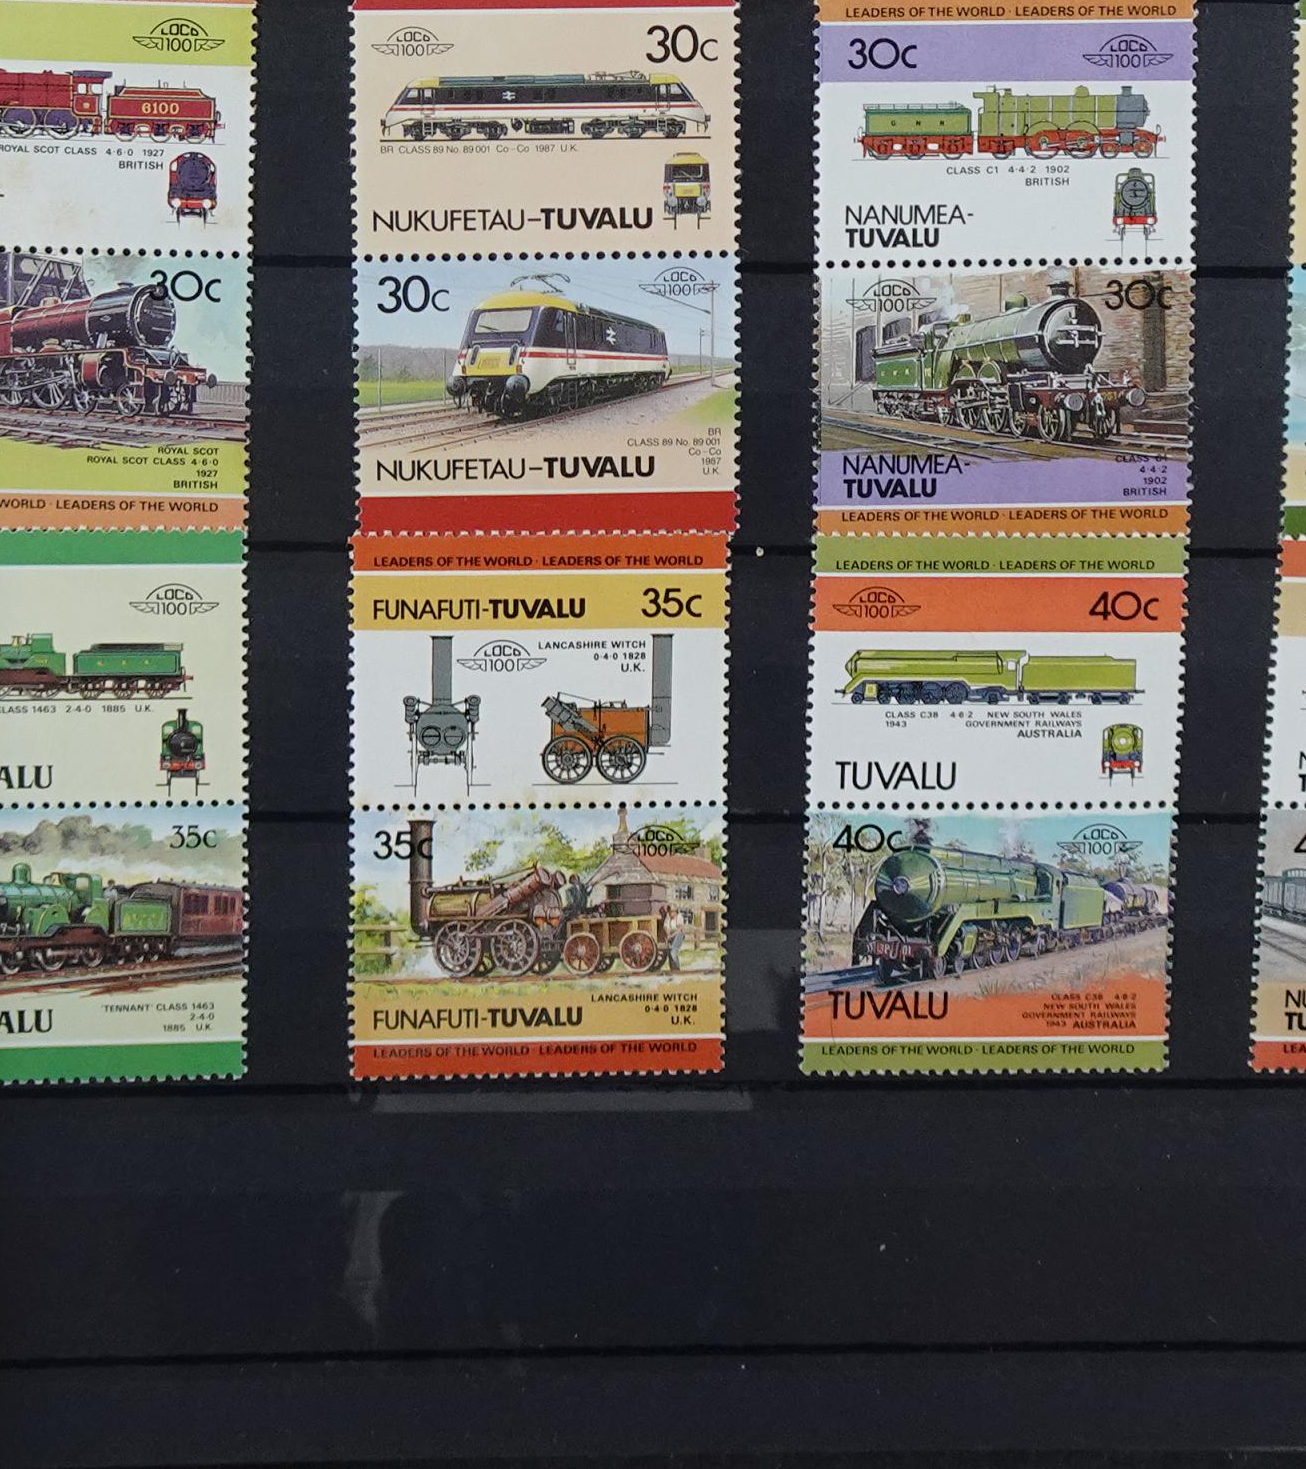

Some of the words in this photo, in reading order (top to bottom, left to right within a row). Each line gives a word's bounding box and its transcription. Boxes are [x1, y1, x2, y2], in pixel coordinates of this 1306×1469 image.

[645, 24, 718, 64] 30c
[847, 38, 918, 70] 30c
[141, 102, 180, 116] 6100
[142, 148, 164, 158] 1927
[398, 145, 432, 154] CLASS
[534, 144, 555, 153] 1987
[118, 160, 164, 170] BRITISH
[946, 165, 981, 175] CLASS
[1045, 165, 1070, 174] 1902
[1024, 177, 1070, 187] BRITISH
[845, 228, 940, 248] TUVALU
[149, 269, 222, 304] 30c
[376, 275, 450, 314] 30c
[1105, 279, 1173, 311] 30c
[173, 479, 219, 490] BRITISH
[843, 478, 937, 499] TUVALU
[1122, 487, 1167, 497] BRITISH
[640, 588, 703, 618] 35c
[1088, 591, 1159, 621] 40c
[538, 640, 607, 650] LANCASHIRE
[611, 639, 647, 649] WITCH
[31, 705, 57, 714] 1463
[885, 711, 916, 719] CLASS
[987, 711, 1010, 719] NEW
[1012, 711, 1046, 719] SOUTH
[1050, 711, 1082, 719] WALES
[1017, 729, 1082, 739] AUSTRALIA
[835, 761, 957, 790] TUVALU
[169, 825, 218, 850] 35c
[373, 830, 434, 860] 35c
[832, 824, 903, 853] 40c
[591, 993, 659, 1003] LANCASHIRE
[662, 992, 698, 1003] WITCH
[828, 991, 949, 1020] TUVALU
[821, 1044, 878, 1056] LEADERS
[881, 1044, 898, 1055] OF
[899, 1044, 924, 1055] THE
[926, 1044, 973, 1055] WORLD
